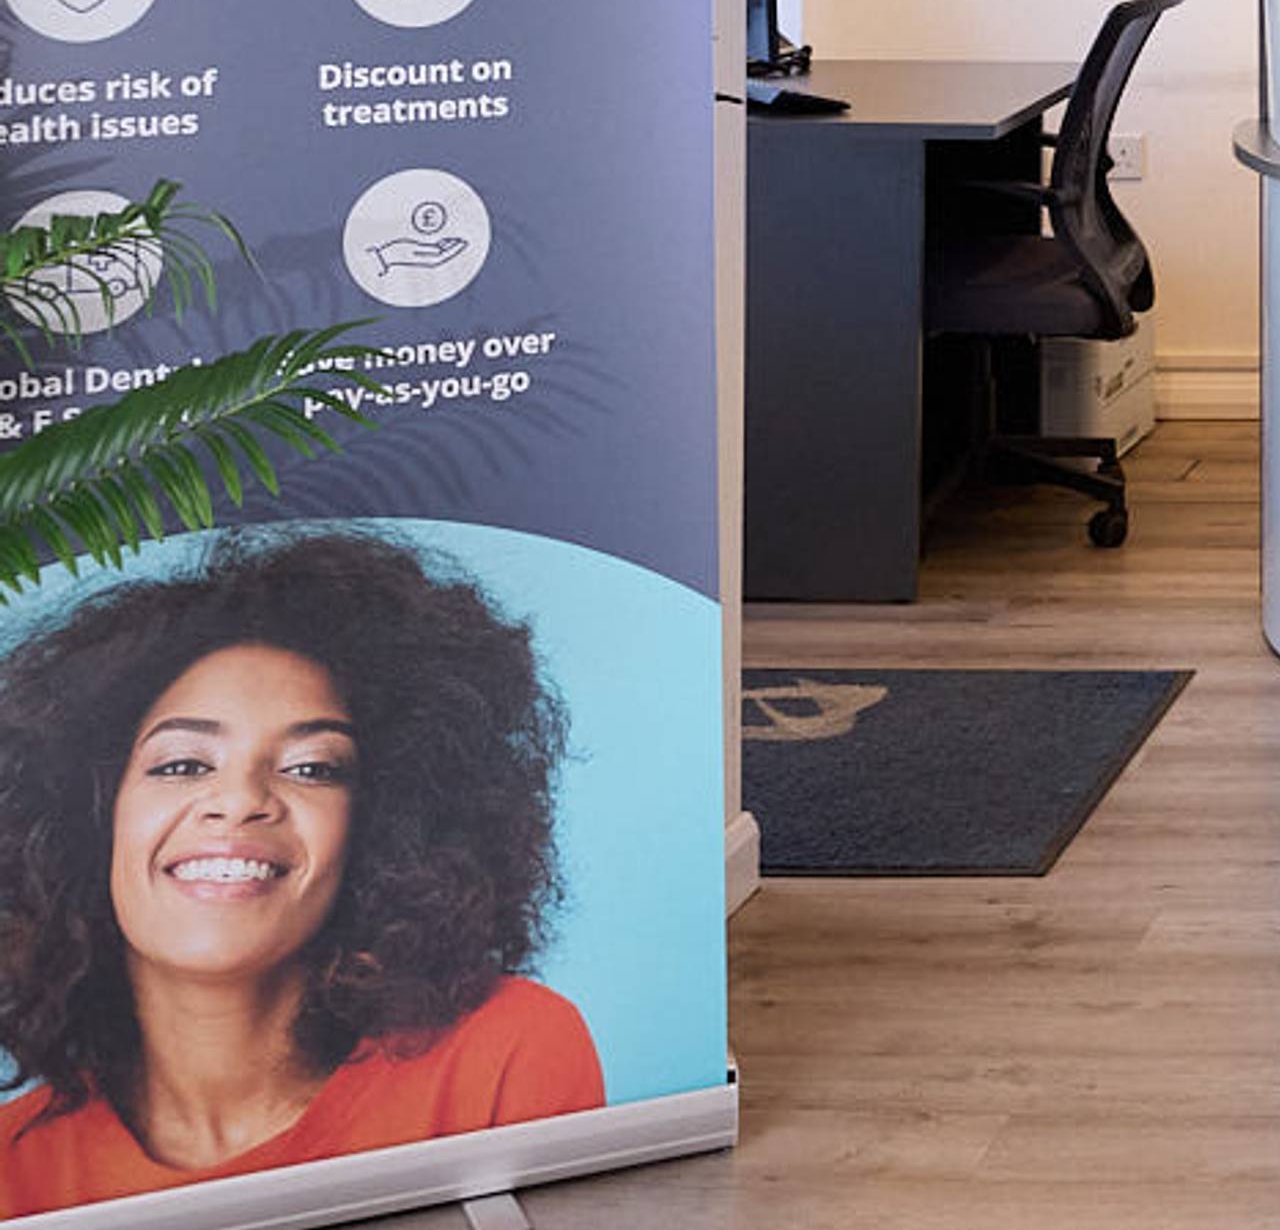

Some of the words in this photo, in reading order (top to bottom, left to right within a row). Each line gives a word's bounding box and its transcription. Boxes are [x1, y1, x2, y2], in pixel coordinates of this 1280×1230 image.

[105, 71, 172, 101] risk
[180, 68, 219, 96] of
[319, 59, 465, 90] Discount
[471, 59, 512, 82] on
[322, 94, 509, 126] treatments
[90, 112, 199, 140] issues
[483, 331, 556, 359] over
